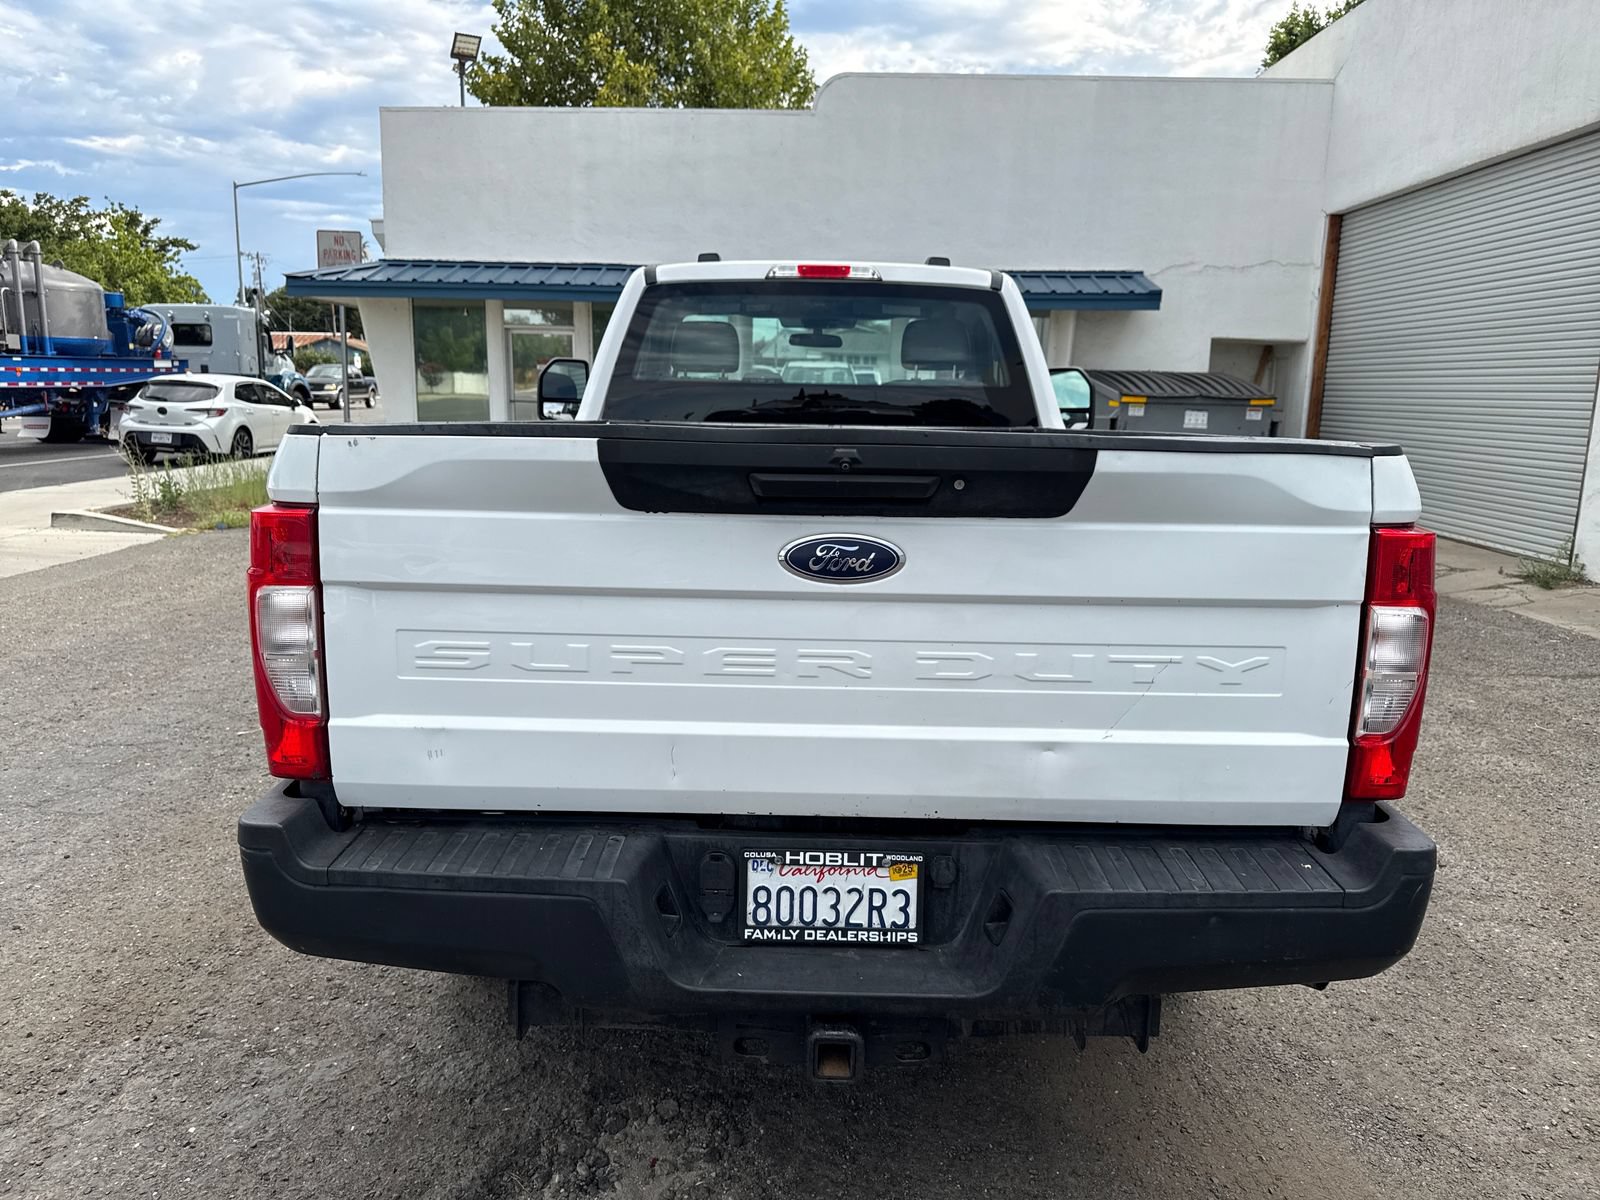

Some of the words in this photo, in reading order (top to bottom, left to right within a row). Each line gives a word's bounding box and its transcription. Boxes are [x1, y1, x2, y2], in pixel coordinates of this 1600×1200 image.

[333, 235, 345, 247] NO
[322, 248, 357, 261] PARKING
[808, 543, 876, 572] Ford
[413, 640, 873, 681] SUPER
[915, 650, 1271, 686] DUTY
[752, 859, 774, 872] DEC
[785, 851, 884, 867] HOBLIT
[886, 854, 924, 862] WOODLAND
[752, 885, 911, 929] 80032R3
[744, 928, 800, 940] FAMILY
[804, 930, 918, 943] DEALERSHIPS
